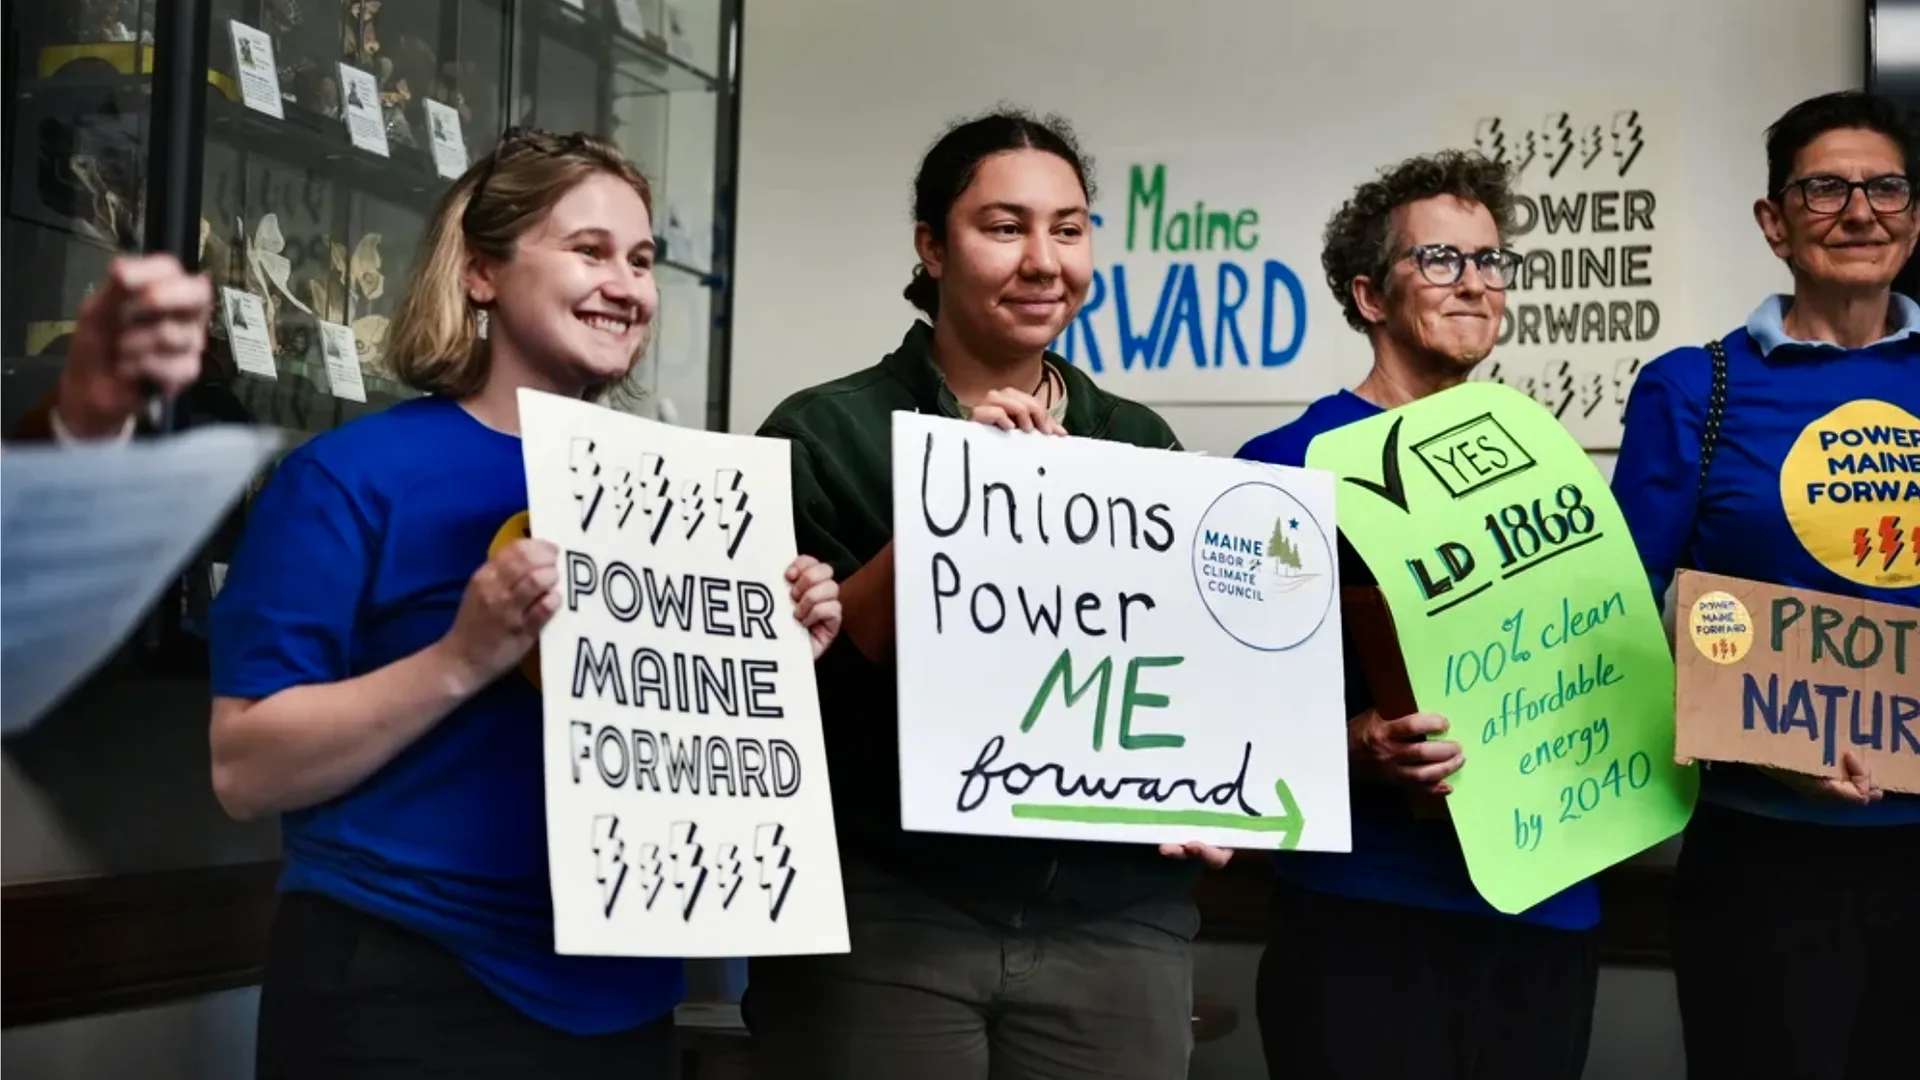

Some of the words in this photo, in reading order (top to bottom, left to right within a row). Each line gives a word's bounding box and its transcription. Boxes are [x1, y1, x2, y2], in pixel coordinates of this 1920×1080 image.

[1125, 163, 1260, 252] Maine
[1501, 190, 1657, 236] OWER
[1508, 245, 1653, 291] AINE
[1050, 258, 1308, 374] RWARD
[1494, 299, 1661, 346] ORWARD
[921, 432, 1176, 552] Unions
[1432, 434, 1508, 484] YES
[1828, 452, 1920, 476] MAINE
[1202, 549, 1244, 568] LABOR
[1203, 564, 1256, 586] CLIMATE
[1204, 529, 1263, 557] MAINE
[1405, 541, 1475, 601] LD
[1485, 483, 1595, 569] 1868
[565, 549, 778, 640] POWER
[932, 552, 1156, 642] Power
[1208, 580, 1264, 602] COUNCIL
[1445, 608, 1532, 697] 100%
[1541, 592, 1626, 650] clean
[1770, 596, 1918, 675] PROT
[571, 637, 785, 719] MAINE
[1020, 648, 1186, 752] ME
[1481, 653, 1625, 744] affordable
[569, 719, 801, 799] FORWARD
[1519, 717, 1610, 775] energy
[1742, 672, 1920, 767] NATUR
[957, 735, 1263, 818] forward
[1514, 808, 1543, 851] by
[1559, 751, 1651, 823] 2040
